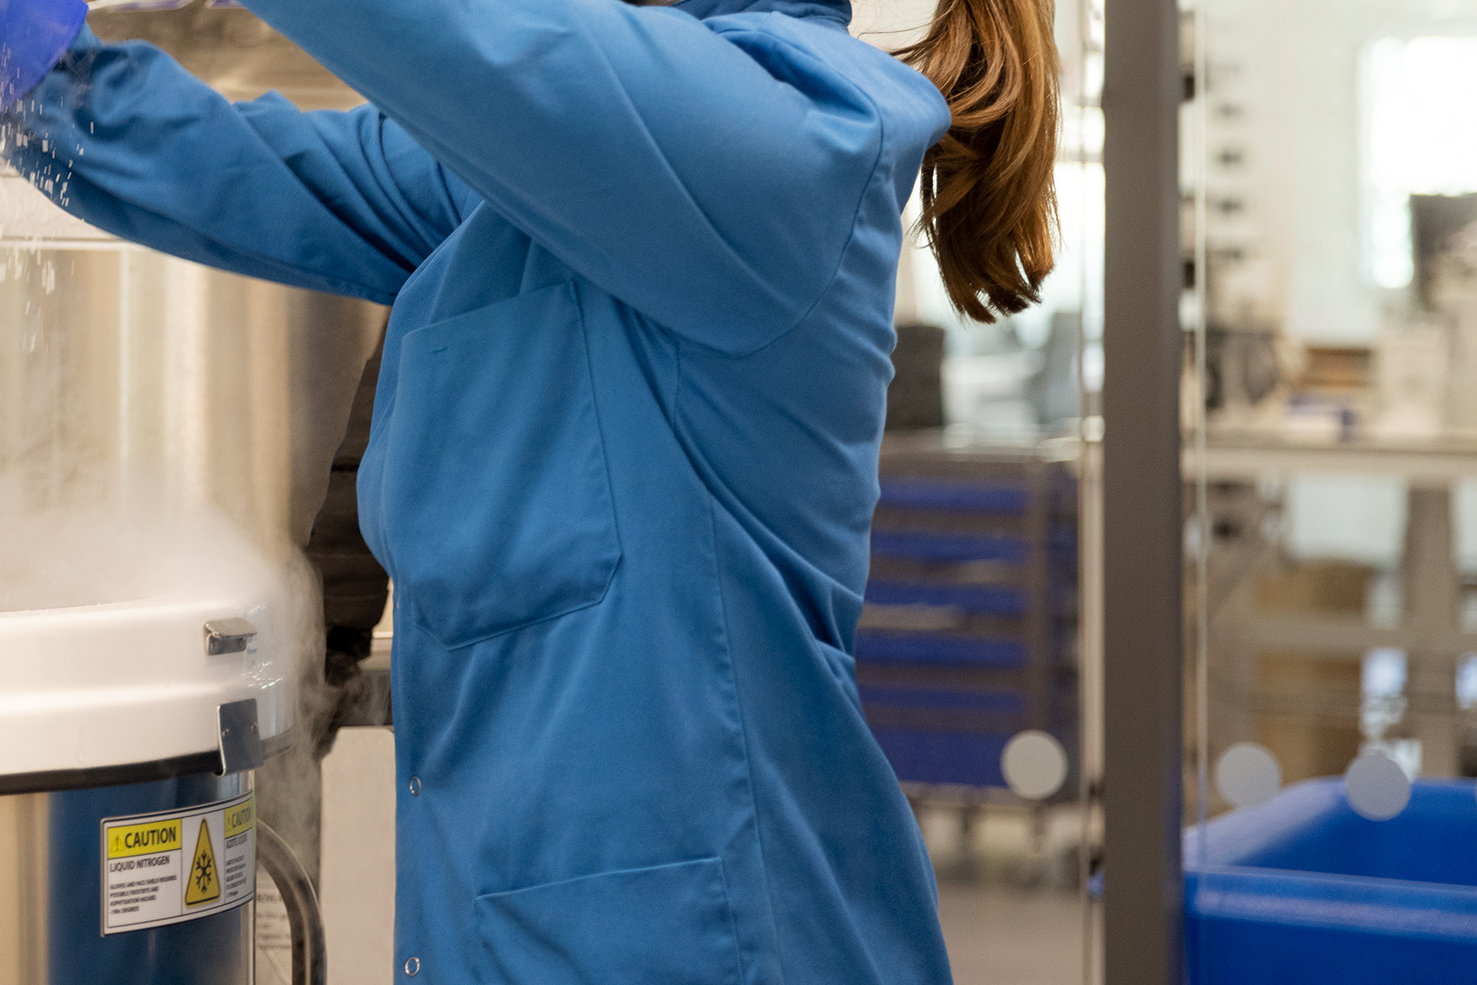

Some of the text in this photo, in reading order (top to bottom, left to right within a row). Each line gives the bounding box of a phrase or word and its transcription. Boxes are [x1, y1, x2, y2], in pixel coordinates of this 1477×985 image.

[124, 826, 176, 849] CAUTION
[110, 855, 170, 873] LIQUID NITROGEN
